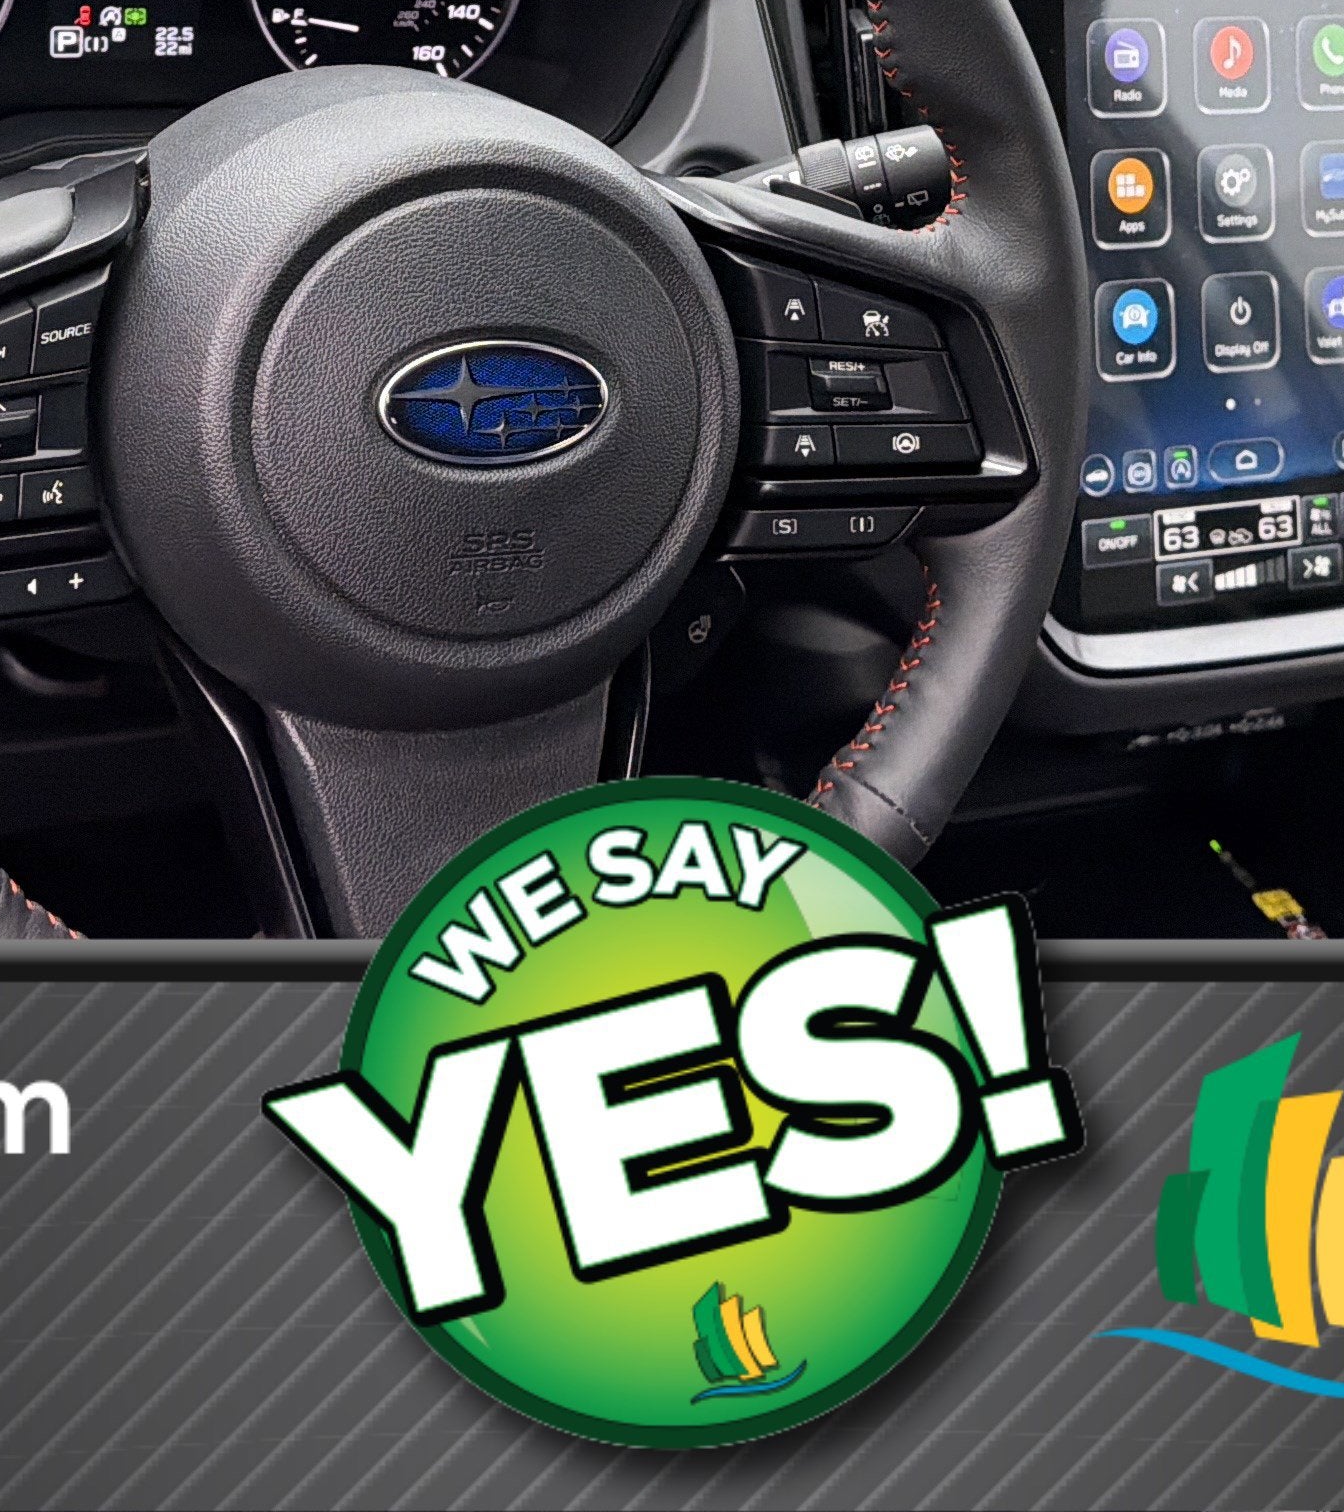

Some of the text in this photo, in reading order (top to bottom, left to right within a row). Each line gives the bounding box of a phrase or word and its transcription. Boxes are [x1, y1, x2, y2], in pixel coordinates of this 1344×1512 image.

[447, 4, 481, 20] 140
[57, 31, 77, 53] P
[155, 26, 195, 42] 22.5
[412, 45, 446, 62] 160
[1113, 89, 1143, 102] Radio
[1218, 86, 1248, 99] Media
[1119, 219, 1146, 234] Apps
[1216, 214, 1259, 229] Settings
[40, 323, 93, 346] SOURCE
[1316, 335, 1343, 349] Valet
[1214, 339, 1270, 358] Display Off
[1115, 350, 1158, 366] Car Info
[829, 360, 866, 373] RES/+
[1258, 514, 1294, 540] 63
[1311, 522, 1333, 537] ALL
[1098, 534, 1139, 553] ON/OFF
[1163, 525, 1200, 552] 63
